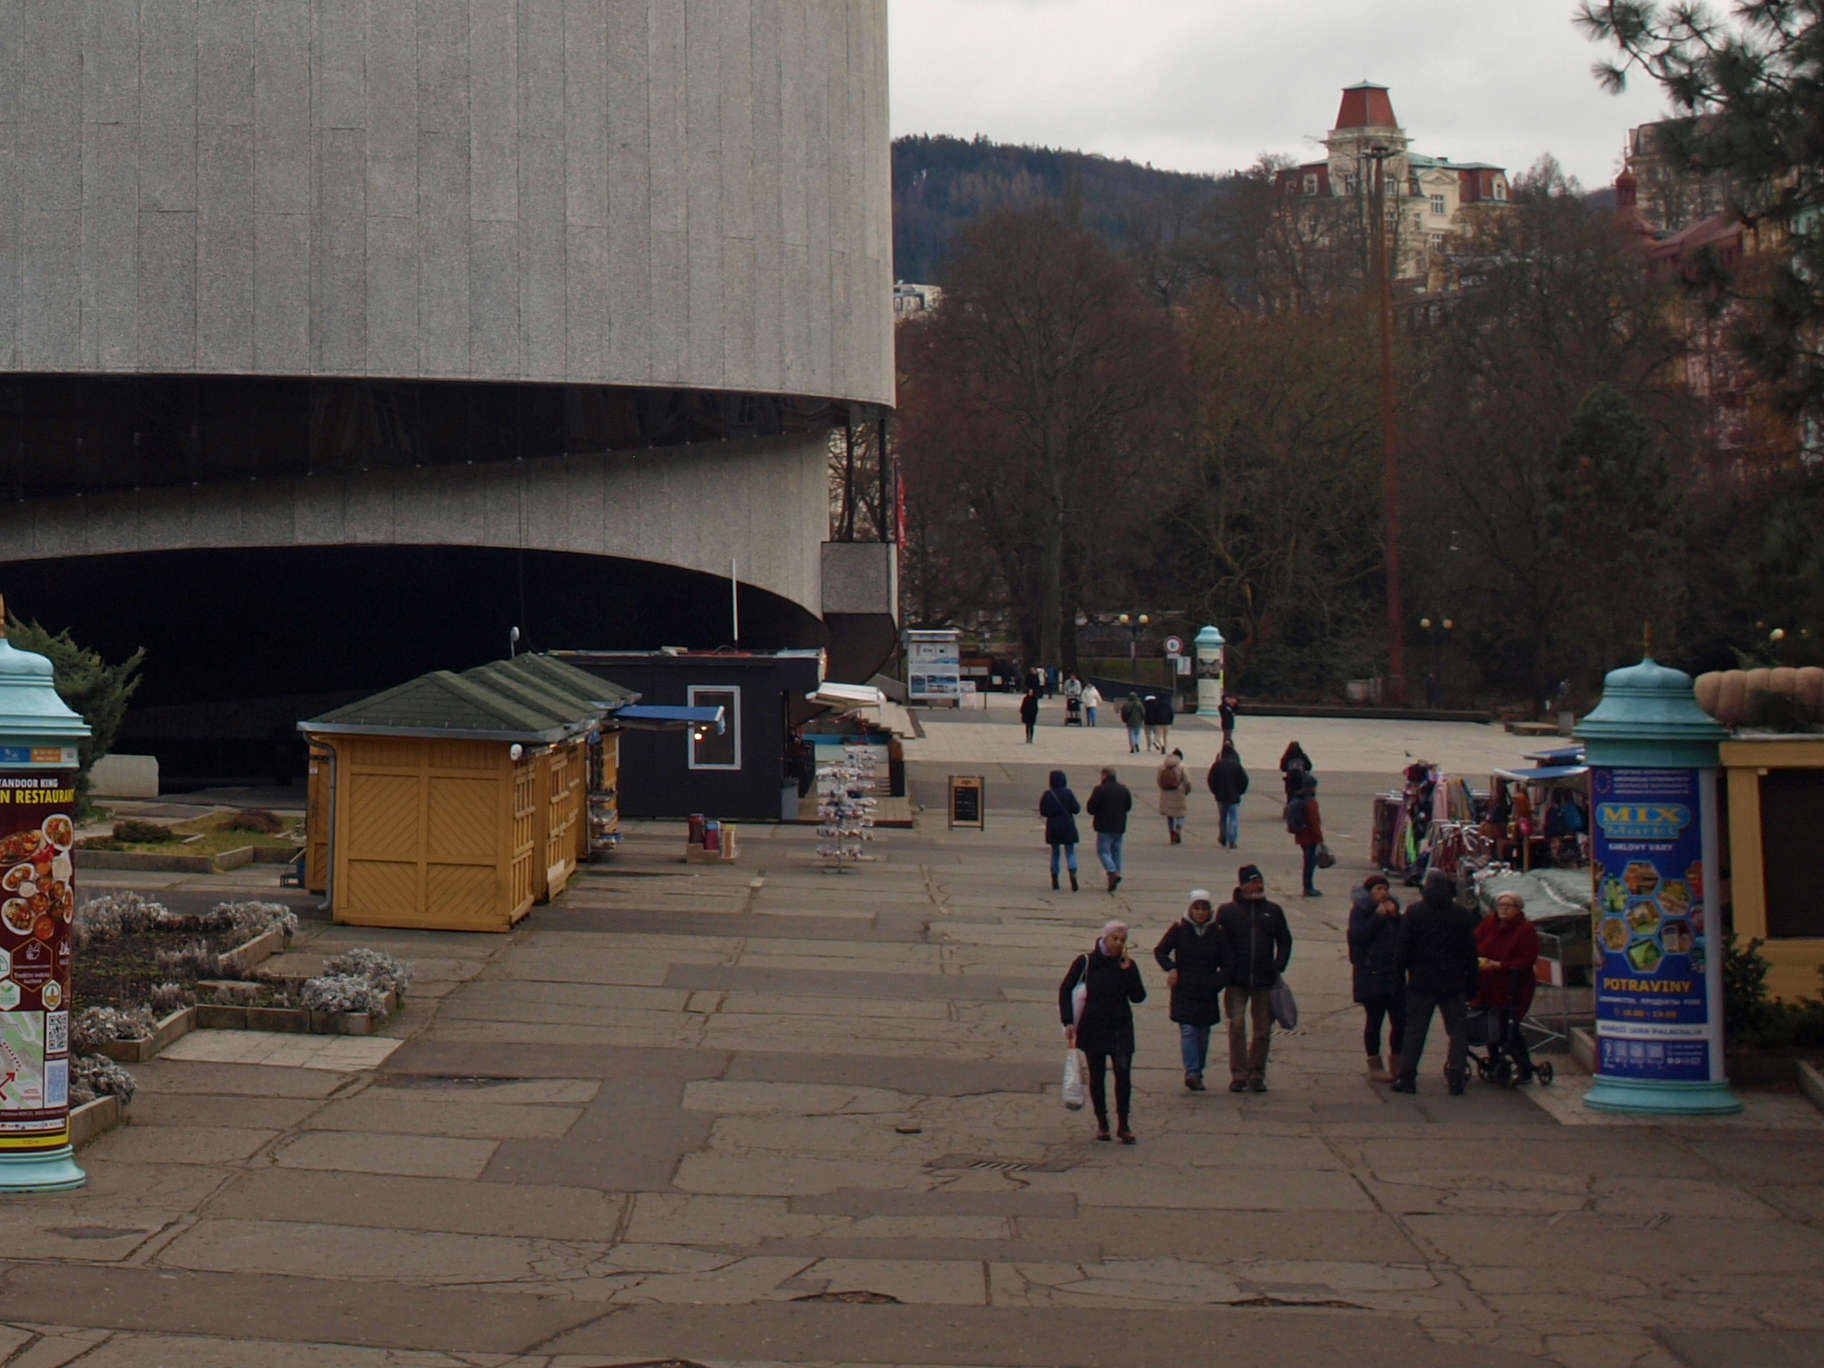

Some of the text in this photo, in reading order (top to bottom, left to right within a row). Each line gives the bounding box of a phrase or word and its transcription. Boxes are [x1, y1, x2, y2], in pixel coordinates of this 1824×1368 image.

[40, 778, 58, 788] KING
[1603, 807, 1681, 823] MIX
[1607, 825, 1674, 836] Markt
[1608, 842, 1673, 851] KARLOVY VARY
[1603, 978, 1691, 993] POTRAVINY
